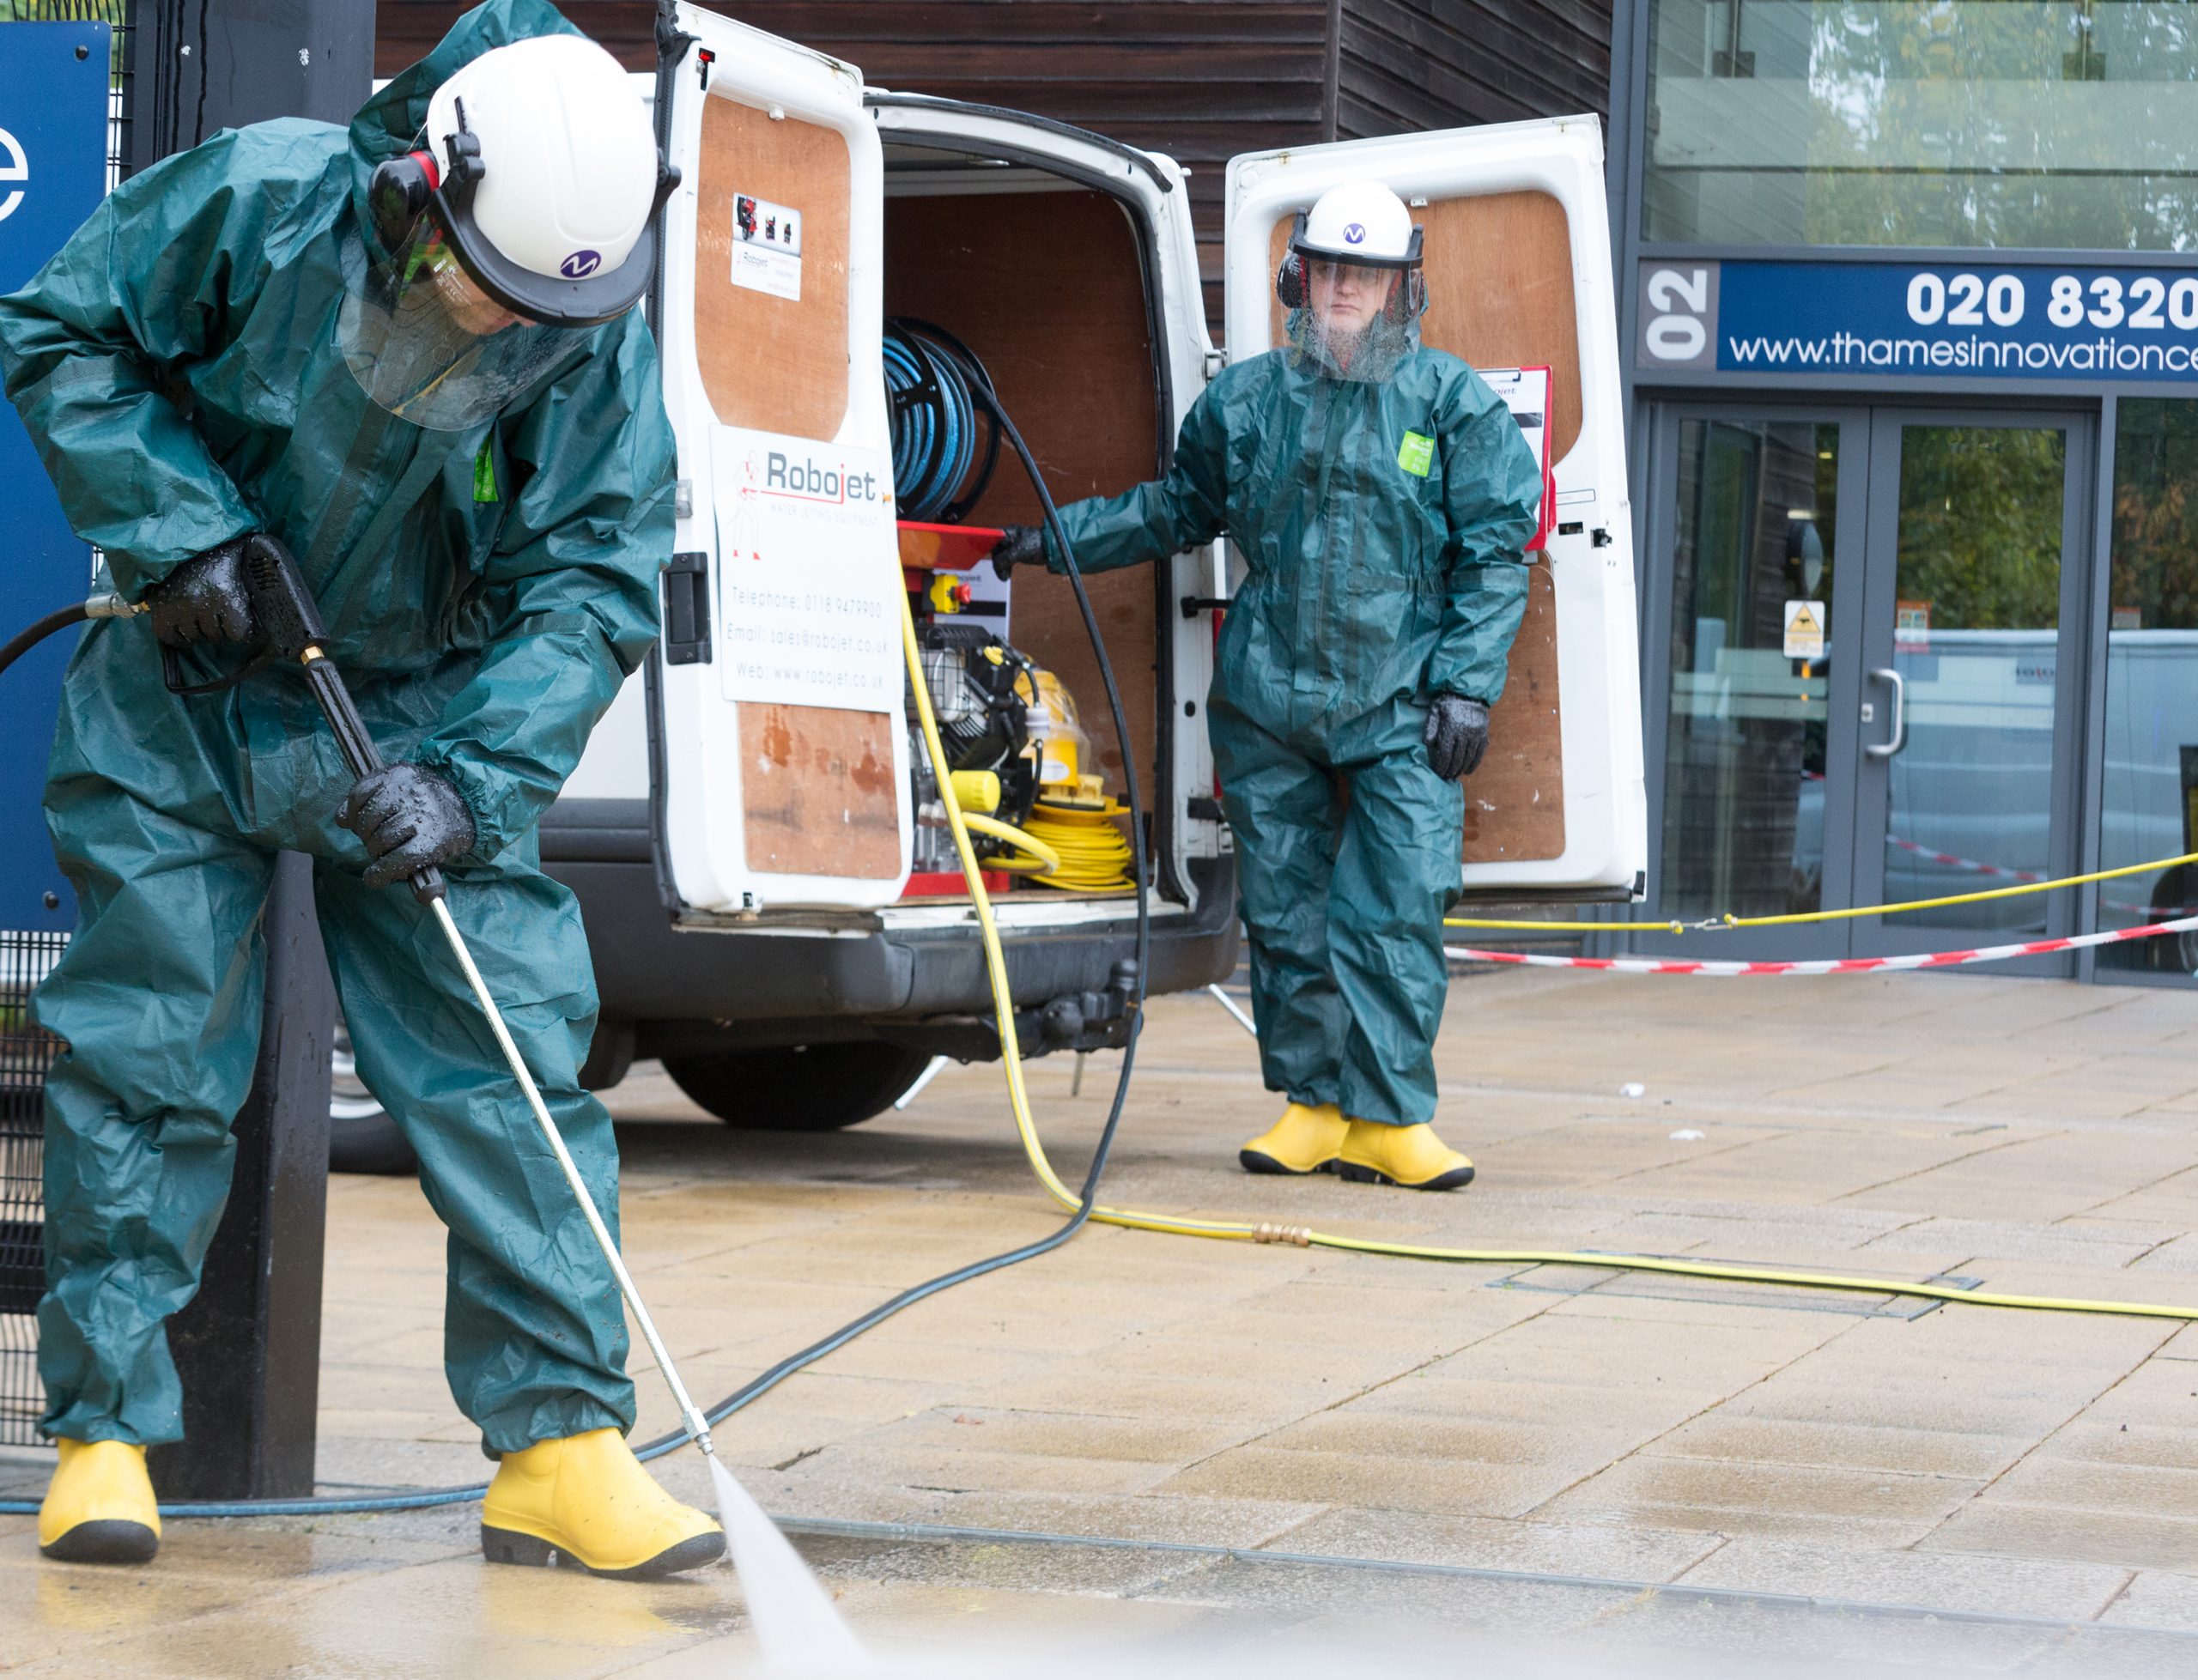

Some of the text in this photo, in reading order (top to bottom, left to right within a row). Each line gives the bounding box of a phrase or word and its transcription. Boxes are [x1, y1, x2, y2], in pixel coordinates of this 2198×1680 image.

[1906, 272, 2198, 331] 020 8320
[767, 452, 876, 504] Robojet
[769, 504, 880, 527] WATER JETTING EQUIPMENT
[732, 586, 882, 619] Telephone: 0118 9479900
[726, 622, 889, 654] Email: sales@robojet.co.uk
[737, 662, 883, 689] Web: www.robojet.co.uk
